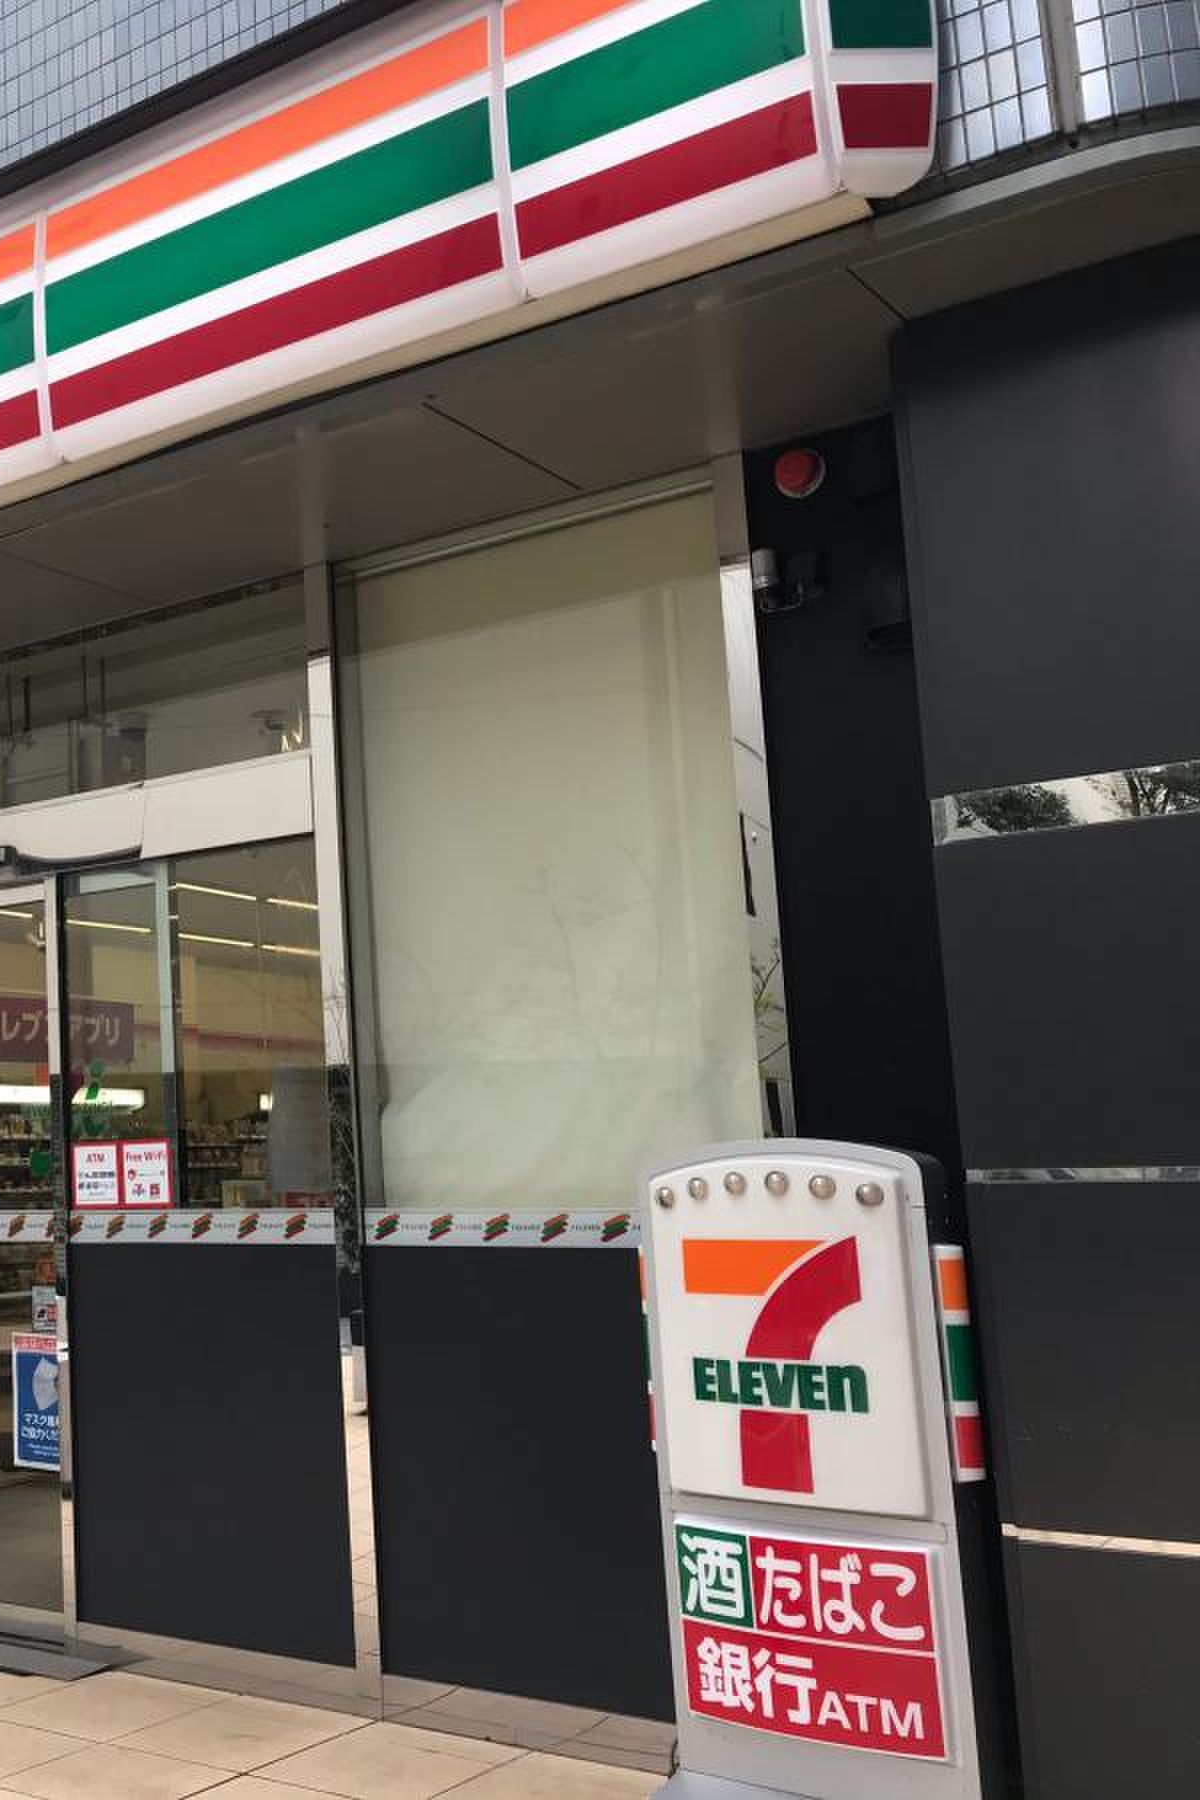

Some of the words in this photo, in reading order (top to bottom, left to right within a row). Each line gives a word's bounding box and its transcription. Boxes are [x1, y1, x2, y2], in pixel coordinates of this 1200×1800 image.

[86, 1153, 105, 1163] ATM
[681, 1533, 745, 1618] 酒
[755, 1546, 925, 1640] たばこ
